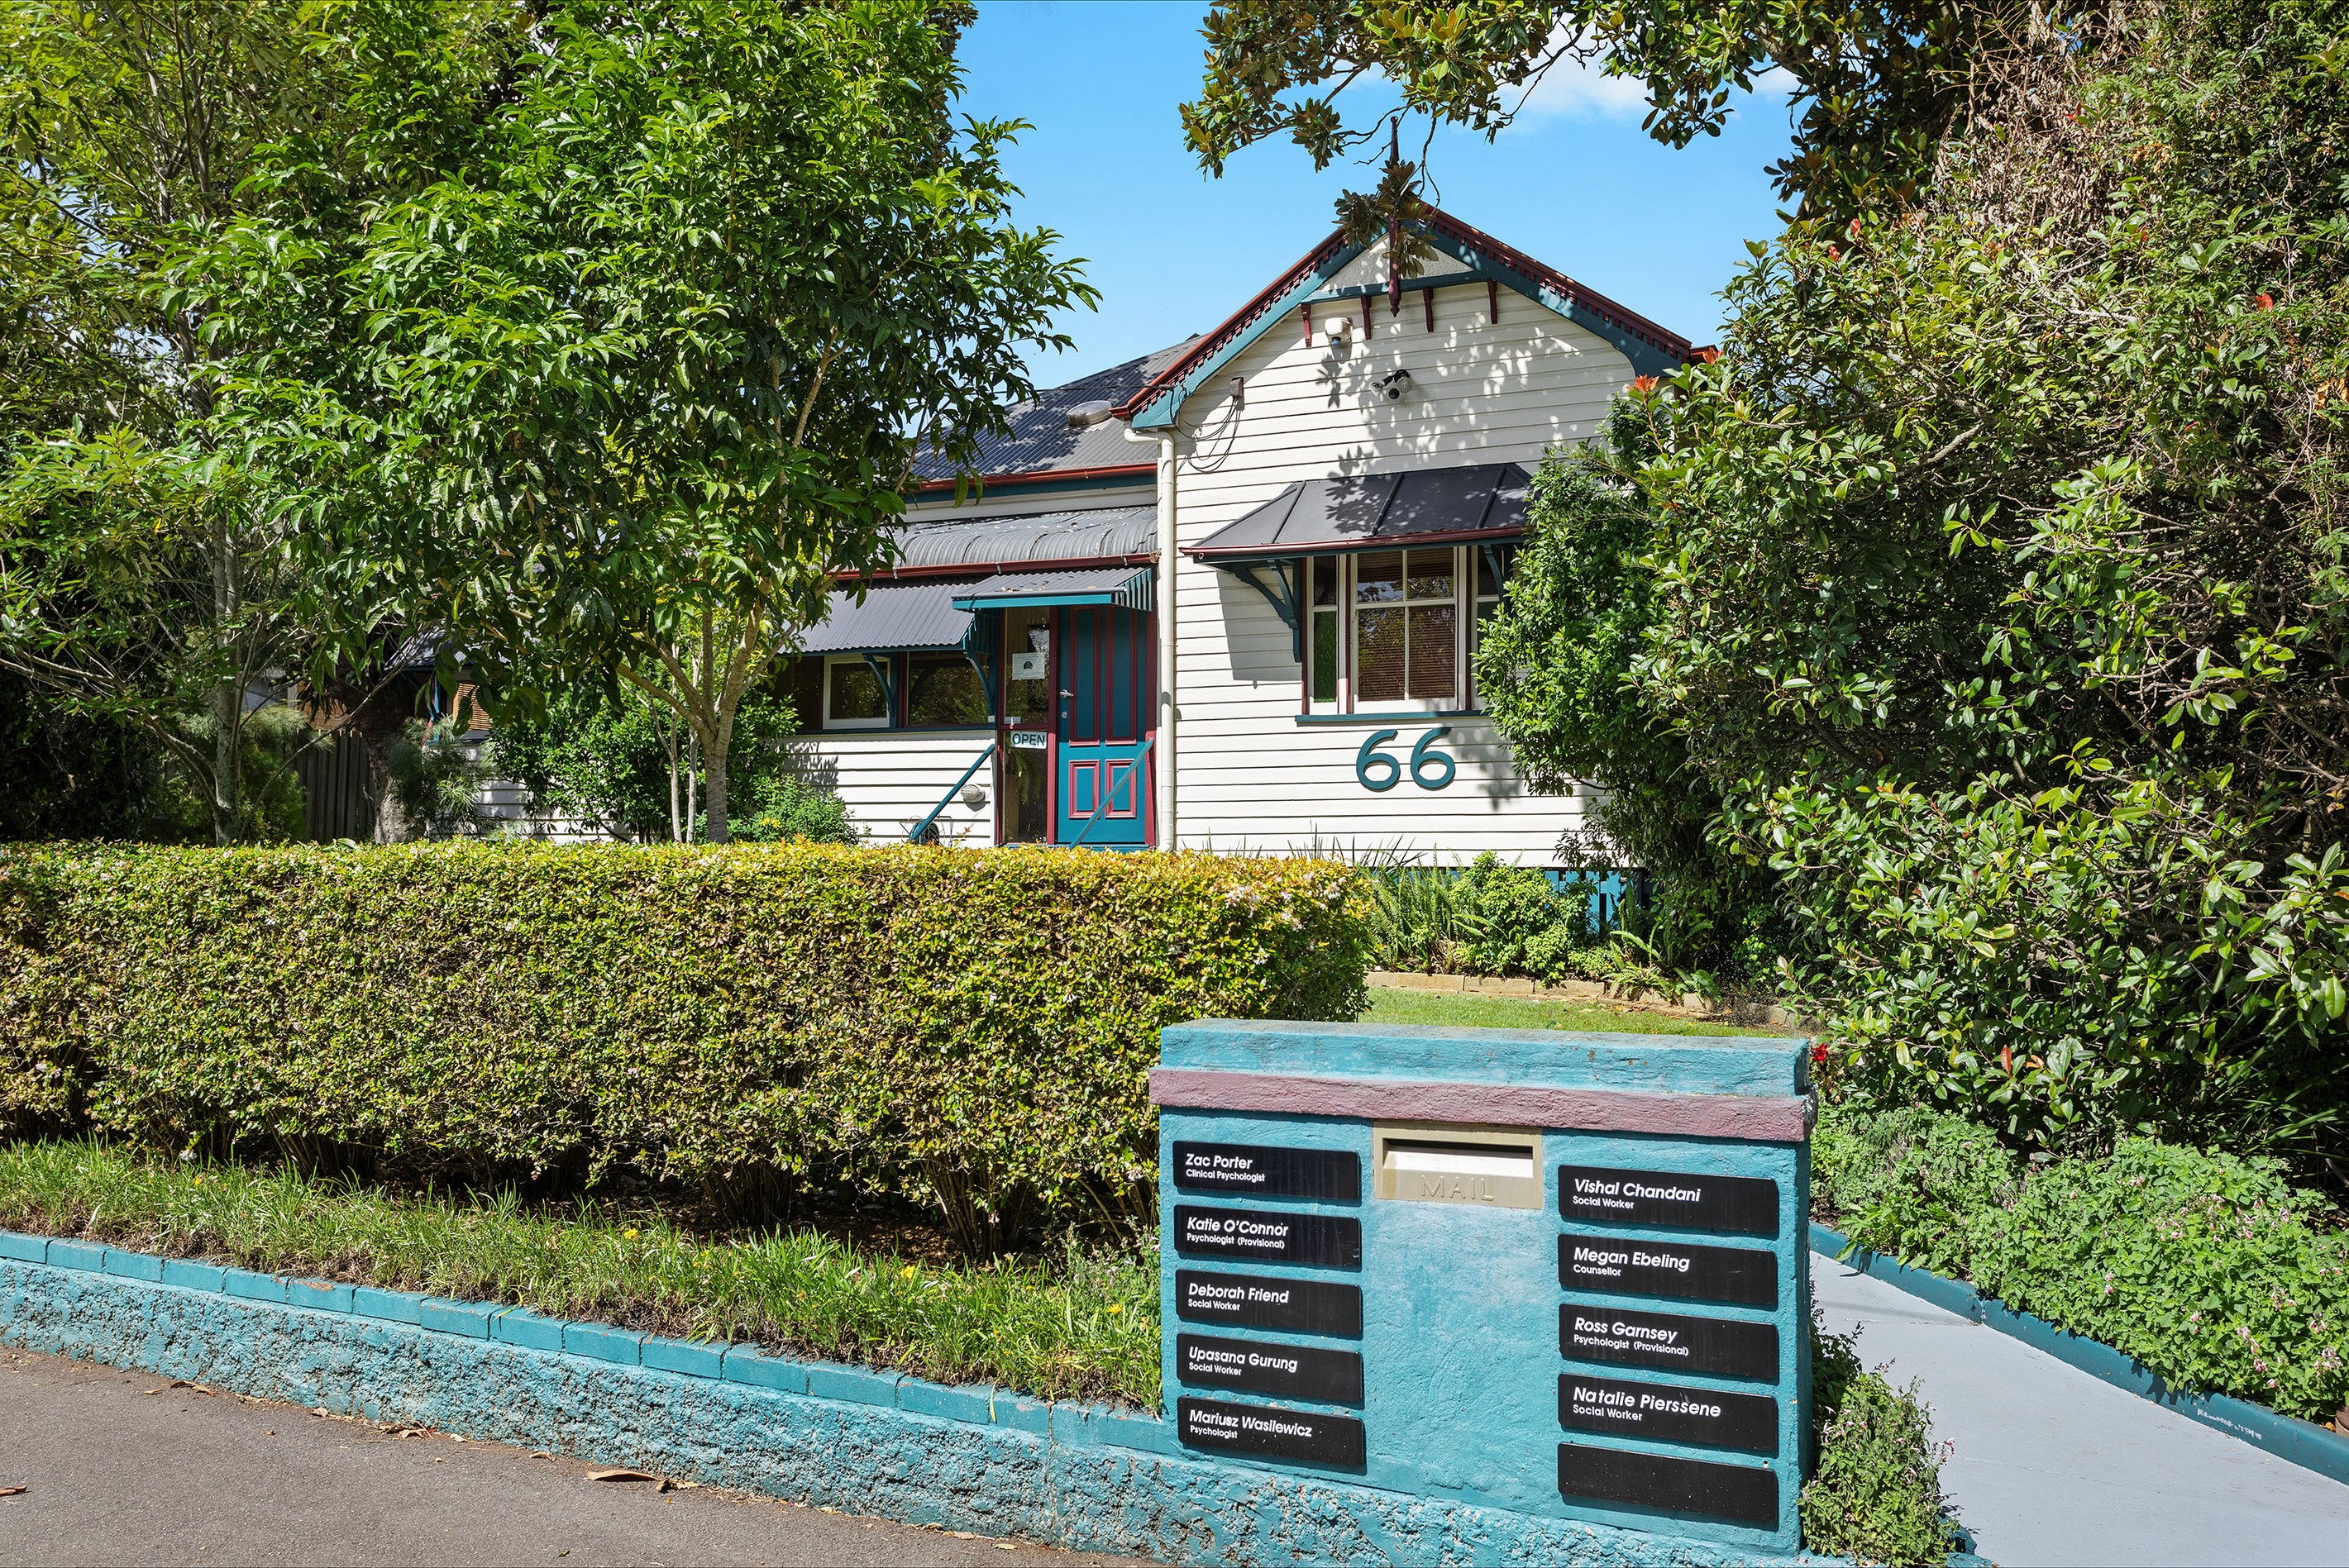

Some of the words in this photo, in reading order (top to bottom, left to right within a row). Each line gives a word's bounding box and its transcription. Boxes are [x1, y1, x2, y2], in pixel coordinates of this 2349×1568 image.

[1012, 732, 1046, 747] OPEN
[1356, 727, 1455, 790] 66
[1185, 1153, 1210, 1167] Zac
[1213, 1155, 1253, 1170] Porter
[1186, 1169, 1215, 1180] Clinical
[1216, 1170, 1265, 1183] Psychologist
[1421, 1175, 1494, 1201] MAIL
[1574, 1178, 1619, 1195] Vishal
[1622, 1183, 1702, 1202] Chandani
[1573, 1195, 1601, 1207] Social
[1602, 1198, 1635, 1209] Worker
[1186, 1217, 1220, 1232] Katie
[1186, 1232, 1234, 1246] Psychologist
[1237, 1237, 1285, 1249] (Provisional)
[1573, 1247, 1629, 1266] Megan
[1632, 1251, 1690, 1272] Ebeling
[1573, 1264, 1621, 1276] Counsellor
[1188, 1282, 1245, 1300] Deborah
[1248, 1287, 1289, 1303] Friend
[1187, 1299, 1211, 1309] Social
[1213, 1300, 1240, 1311] Worker
[1574, 1317, 1608, 1334] Ross
[1611, 1322, 1678, 1344] Garnsey
[1573, 1334, 1630, 1350] Psychologist
[1633, 1341, 1689, 1356] (Provisional)
[1189, 1346, 1245, 1365] Upasana
[1249, 1353, 1298, 1373] Gurung
[1189, 1362, 1213, 1373] Social
[1214, 1365, 1242, 1376] Worker
[1573, 1387, 1635, 1407] Natalie
[1640, 1394, 1721, 1418] Pierssene
[1573, 1404, 1604, 1417] Social
[1607, 1408, 1642, 1422] Worker
[1189, 1409, 1239, 1427] Mariusz
[1241, 1416, 1312, 1437] Wasilewicz
[1190, 1425, 1238, 1439] Psychologist
